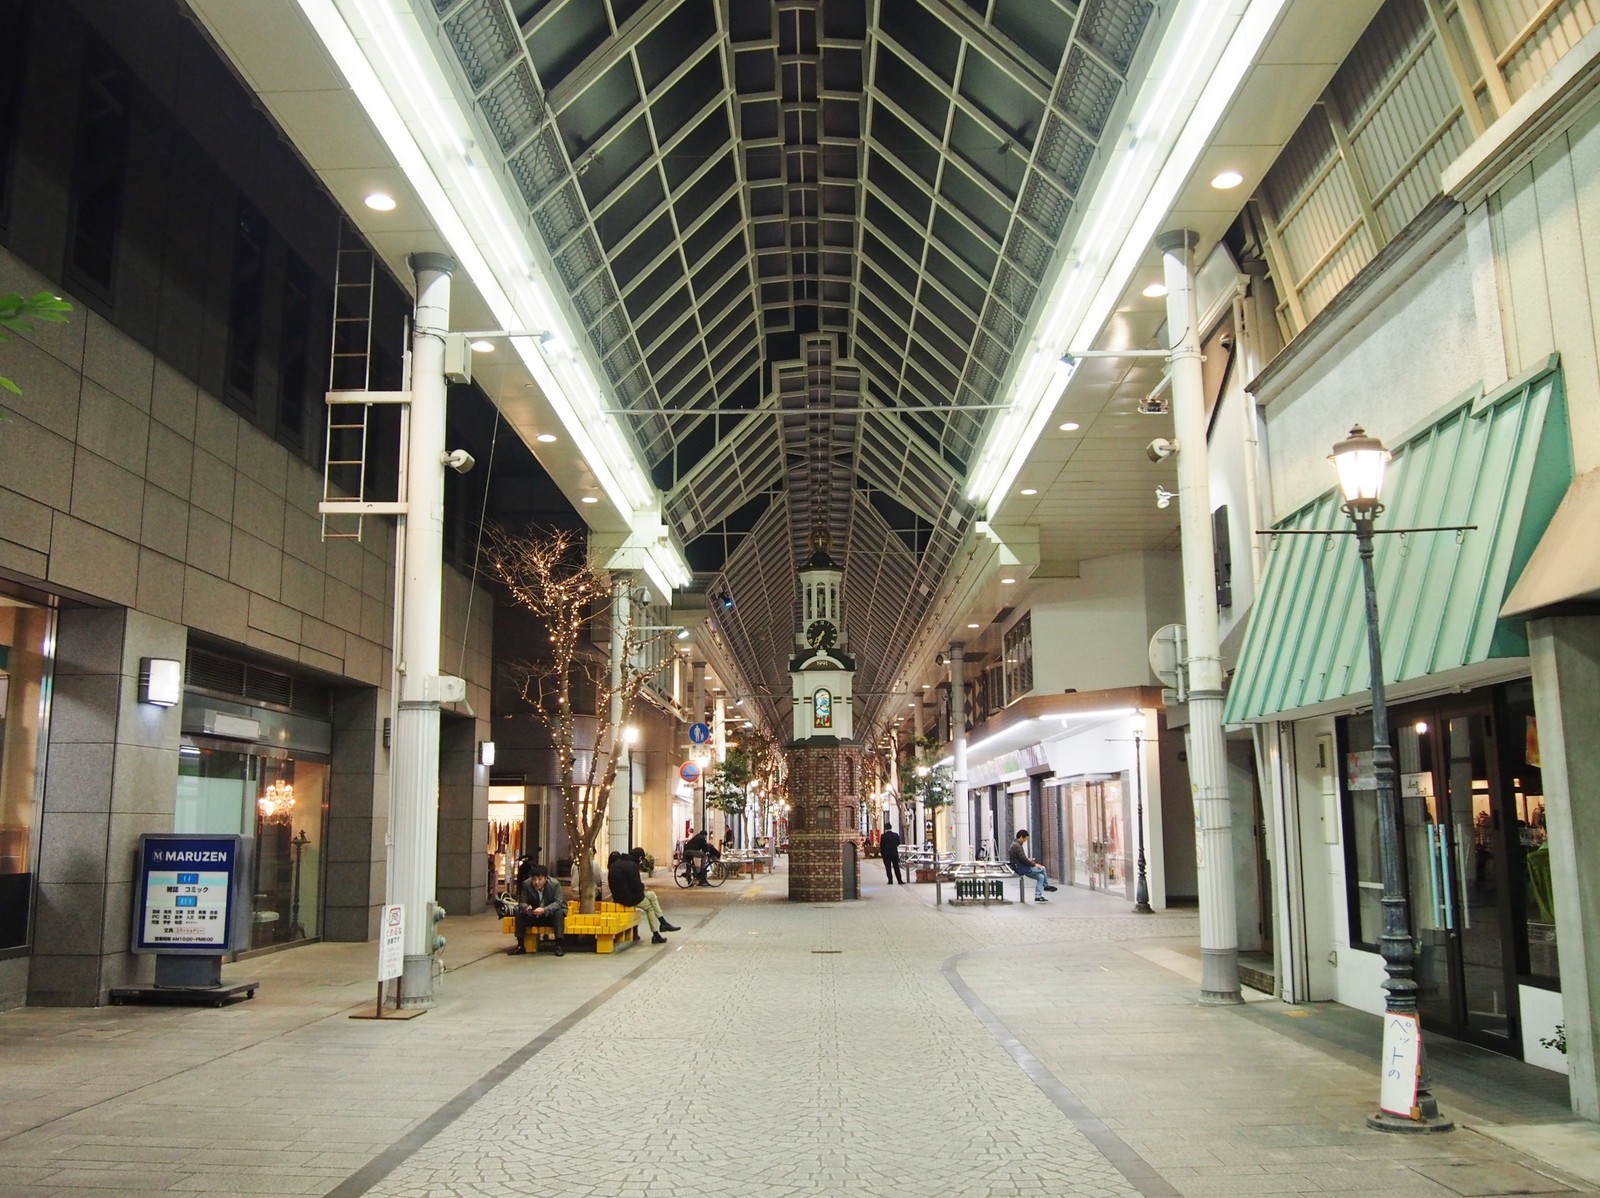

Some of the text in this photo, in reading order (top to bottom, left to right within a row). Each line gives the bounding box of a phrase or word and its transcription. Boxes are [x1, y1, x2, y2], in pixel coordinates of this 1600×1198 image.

[165, 851, 227, 862] MARUZEN
[1388, 1019, 1413, 1081] ペットの
